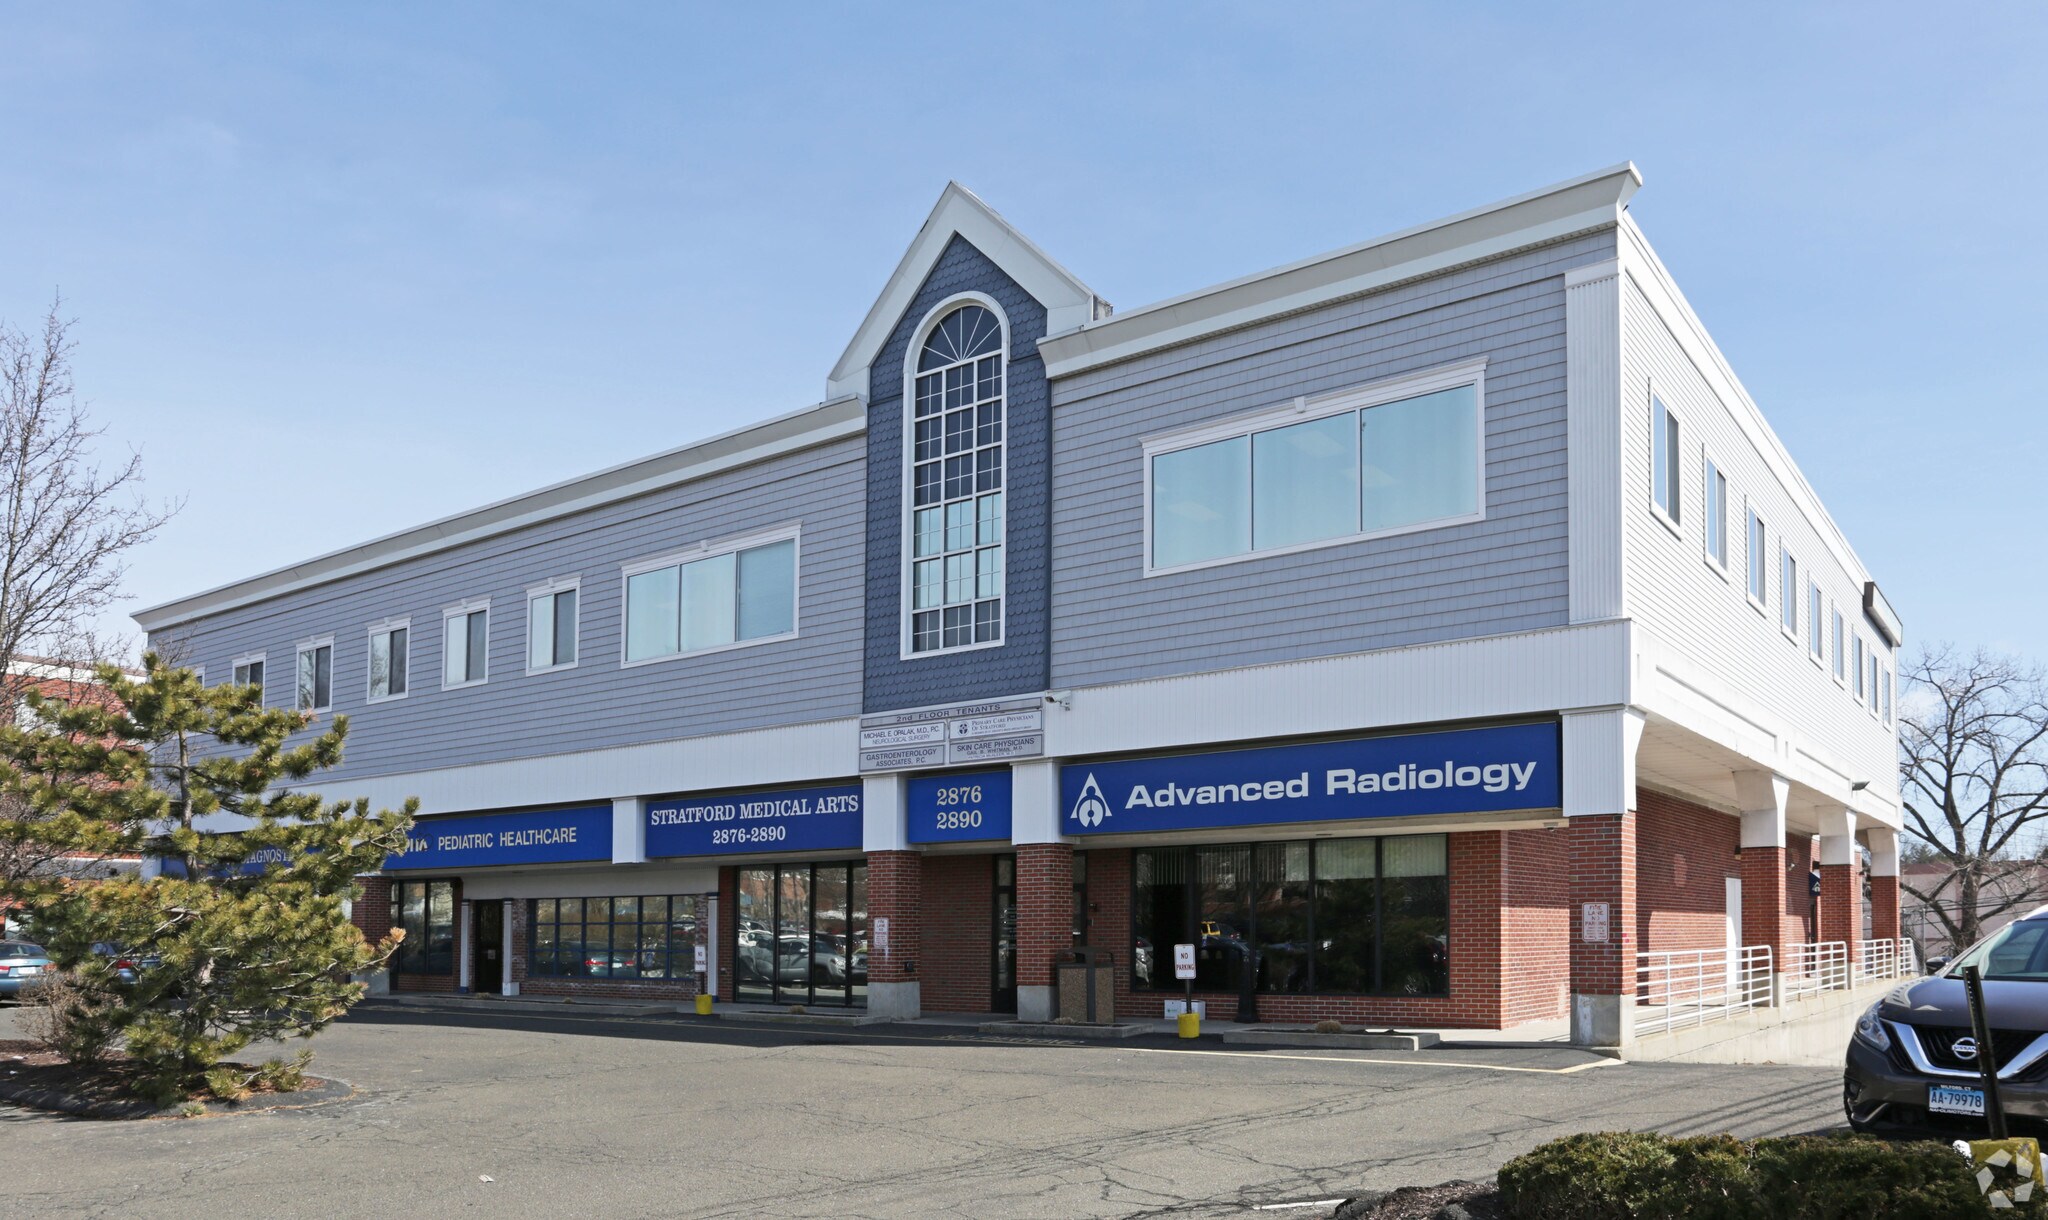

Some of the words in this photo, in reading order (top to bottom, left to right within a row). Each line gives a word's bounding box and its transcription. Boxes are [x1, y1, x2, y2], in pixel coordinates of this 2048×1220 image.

[919, 710, 950, 719] FLOOR
[957, 704, 1000, 715] TENANTS
[864, 731, 886, 739] MICHAEL
[974, 742, 992, 750] CARE
[994, 738, 1035, 749] PHYSICIANS
[866, 748, 937, 761] GASTROENTEROLOGY
[1125, 772, 1309, 809] Advanced
[1326, 761, 1537, 796] Radiology
[936, 785, 982, 806] 2876
[651, 804, 736, 826] STRATFORD
[739, 799, 811, 820] MEDICAL
[815, 794, 859, 815] ARTS
[936, 810, 982, 830] 2890
[438, 832, 494, 850] PEDIATRIC
[500, 827, 577, 847] HEALTHCARE
[713, 825, 786, 845] 2876-2890
